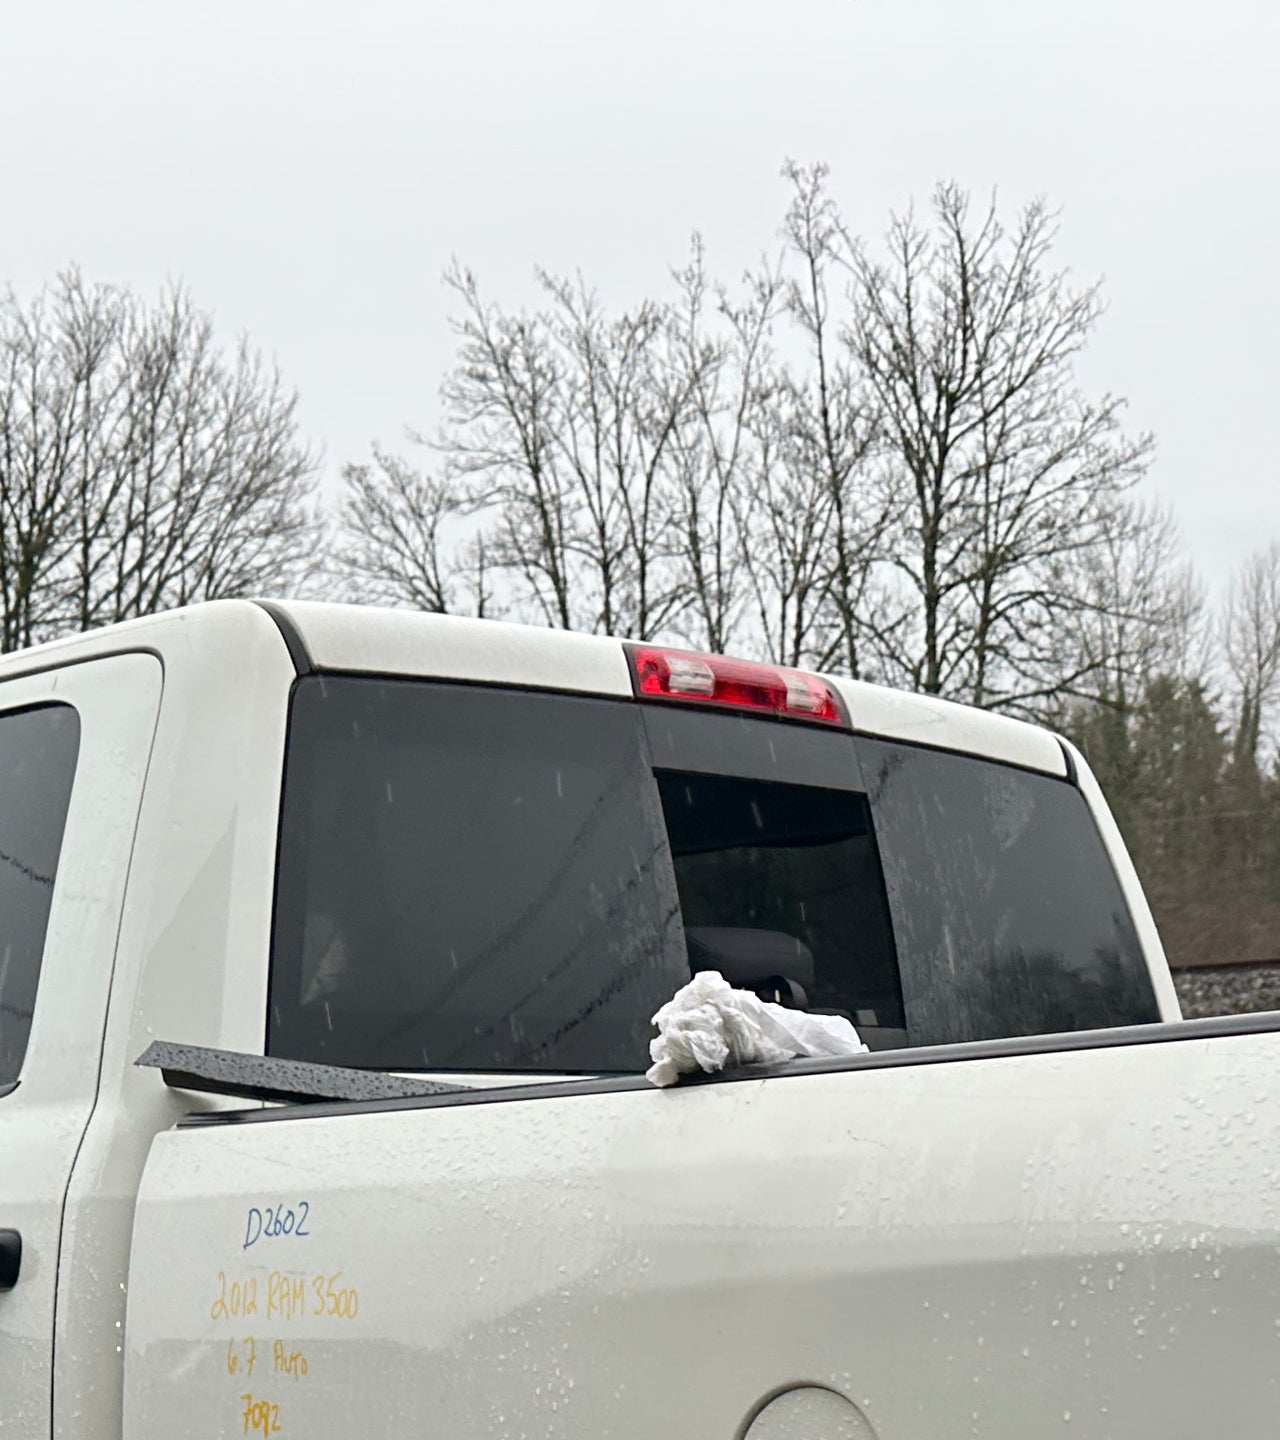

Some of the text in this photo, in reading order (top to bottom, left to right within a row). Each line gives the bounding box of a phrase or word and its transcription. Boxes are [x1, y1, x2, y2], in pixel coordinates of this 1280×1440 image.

[243, 1201, 309, 1249] D2602
[210, 1270, 359, 1320] 2012 RAM 3500
